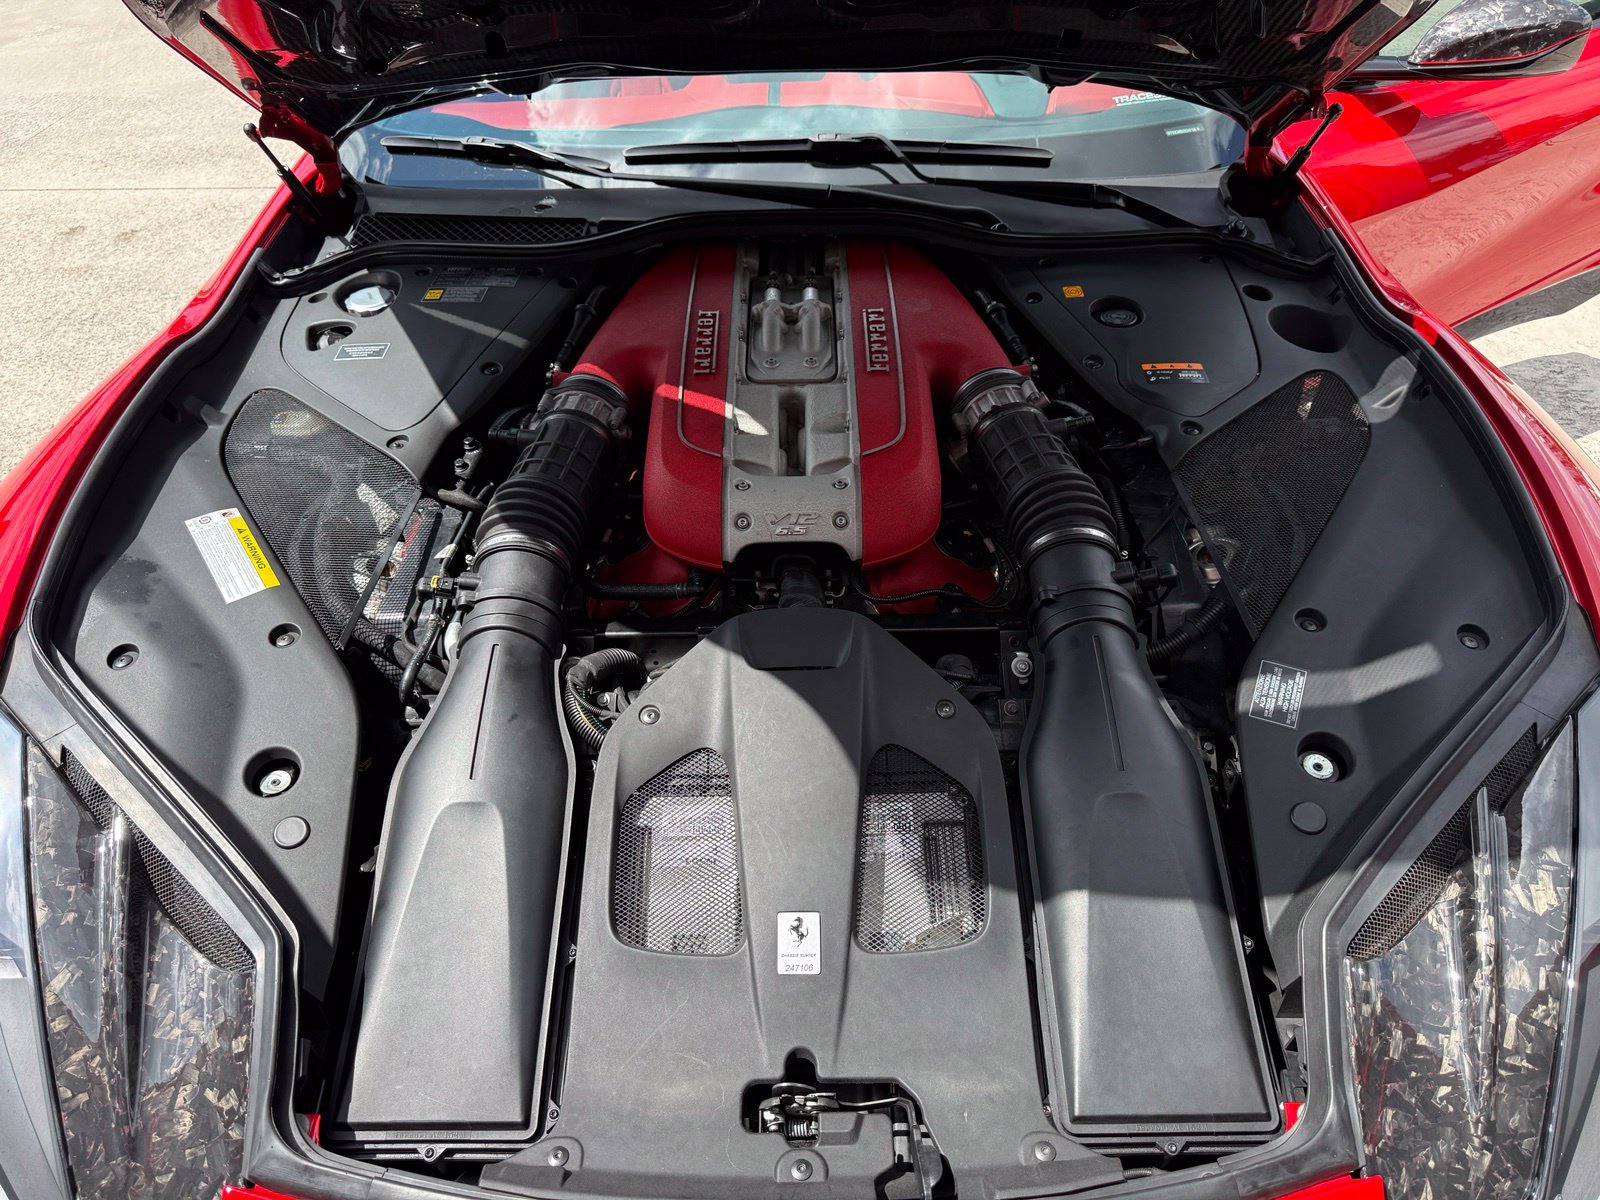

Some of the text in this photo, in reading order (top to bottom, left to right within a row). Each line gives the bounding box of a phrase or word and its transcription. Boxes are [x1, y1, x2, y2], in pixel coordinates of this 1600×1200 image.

[693, 310, 720, 375] Ferrari
[862, 307, 890, 372] Ferrari
[765, 512, 821, 526] V12
[775, 526, 808, 536] 6.5
[242, 533, 267, 570] WARNING
[785, 964, 814, 972] 247106
